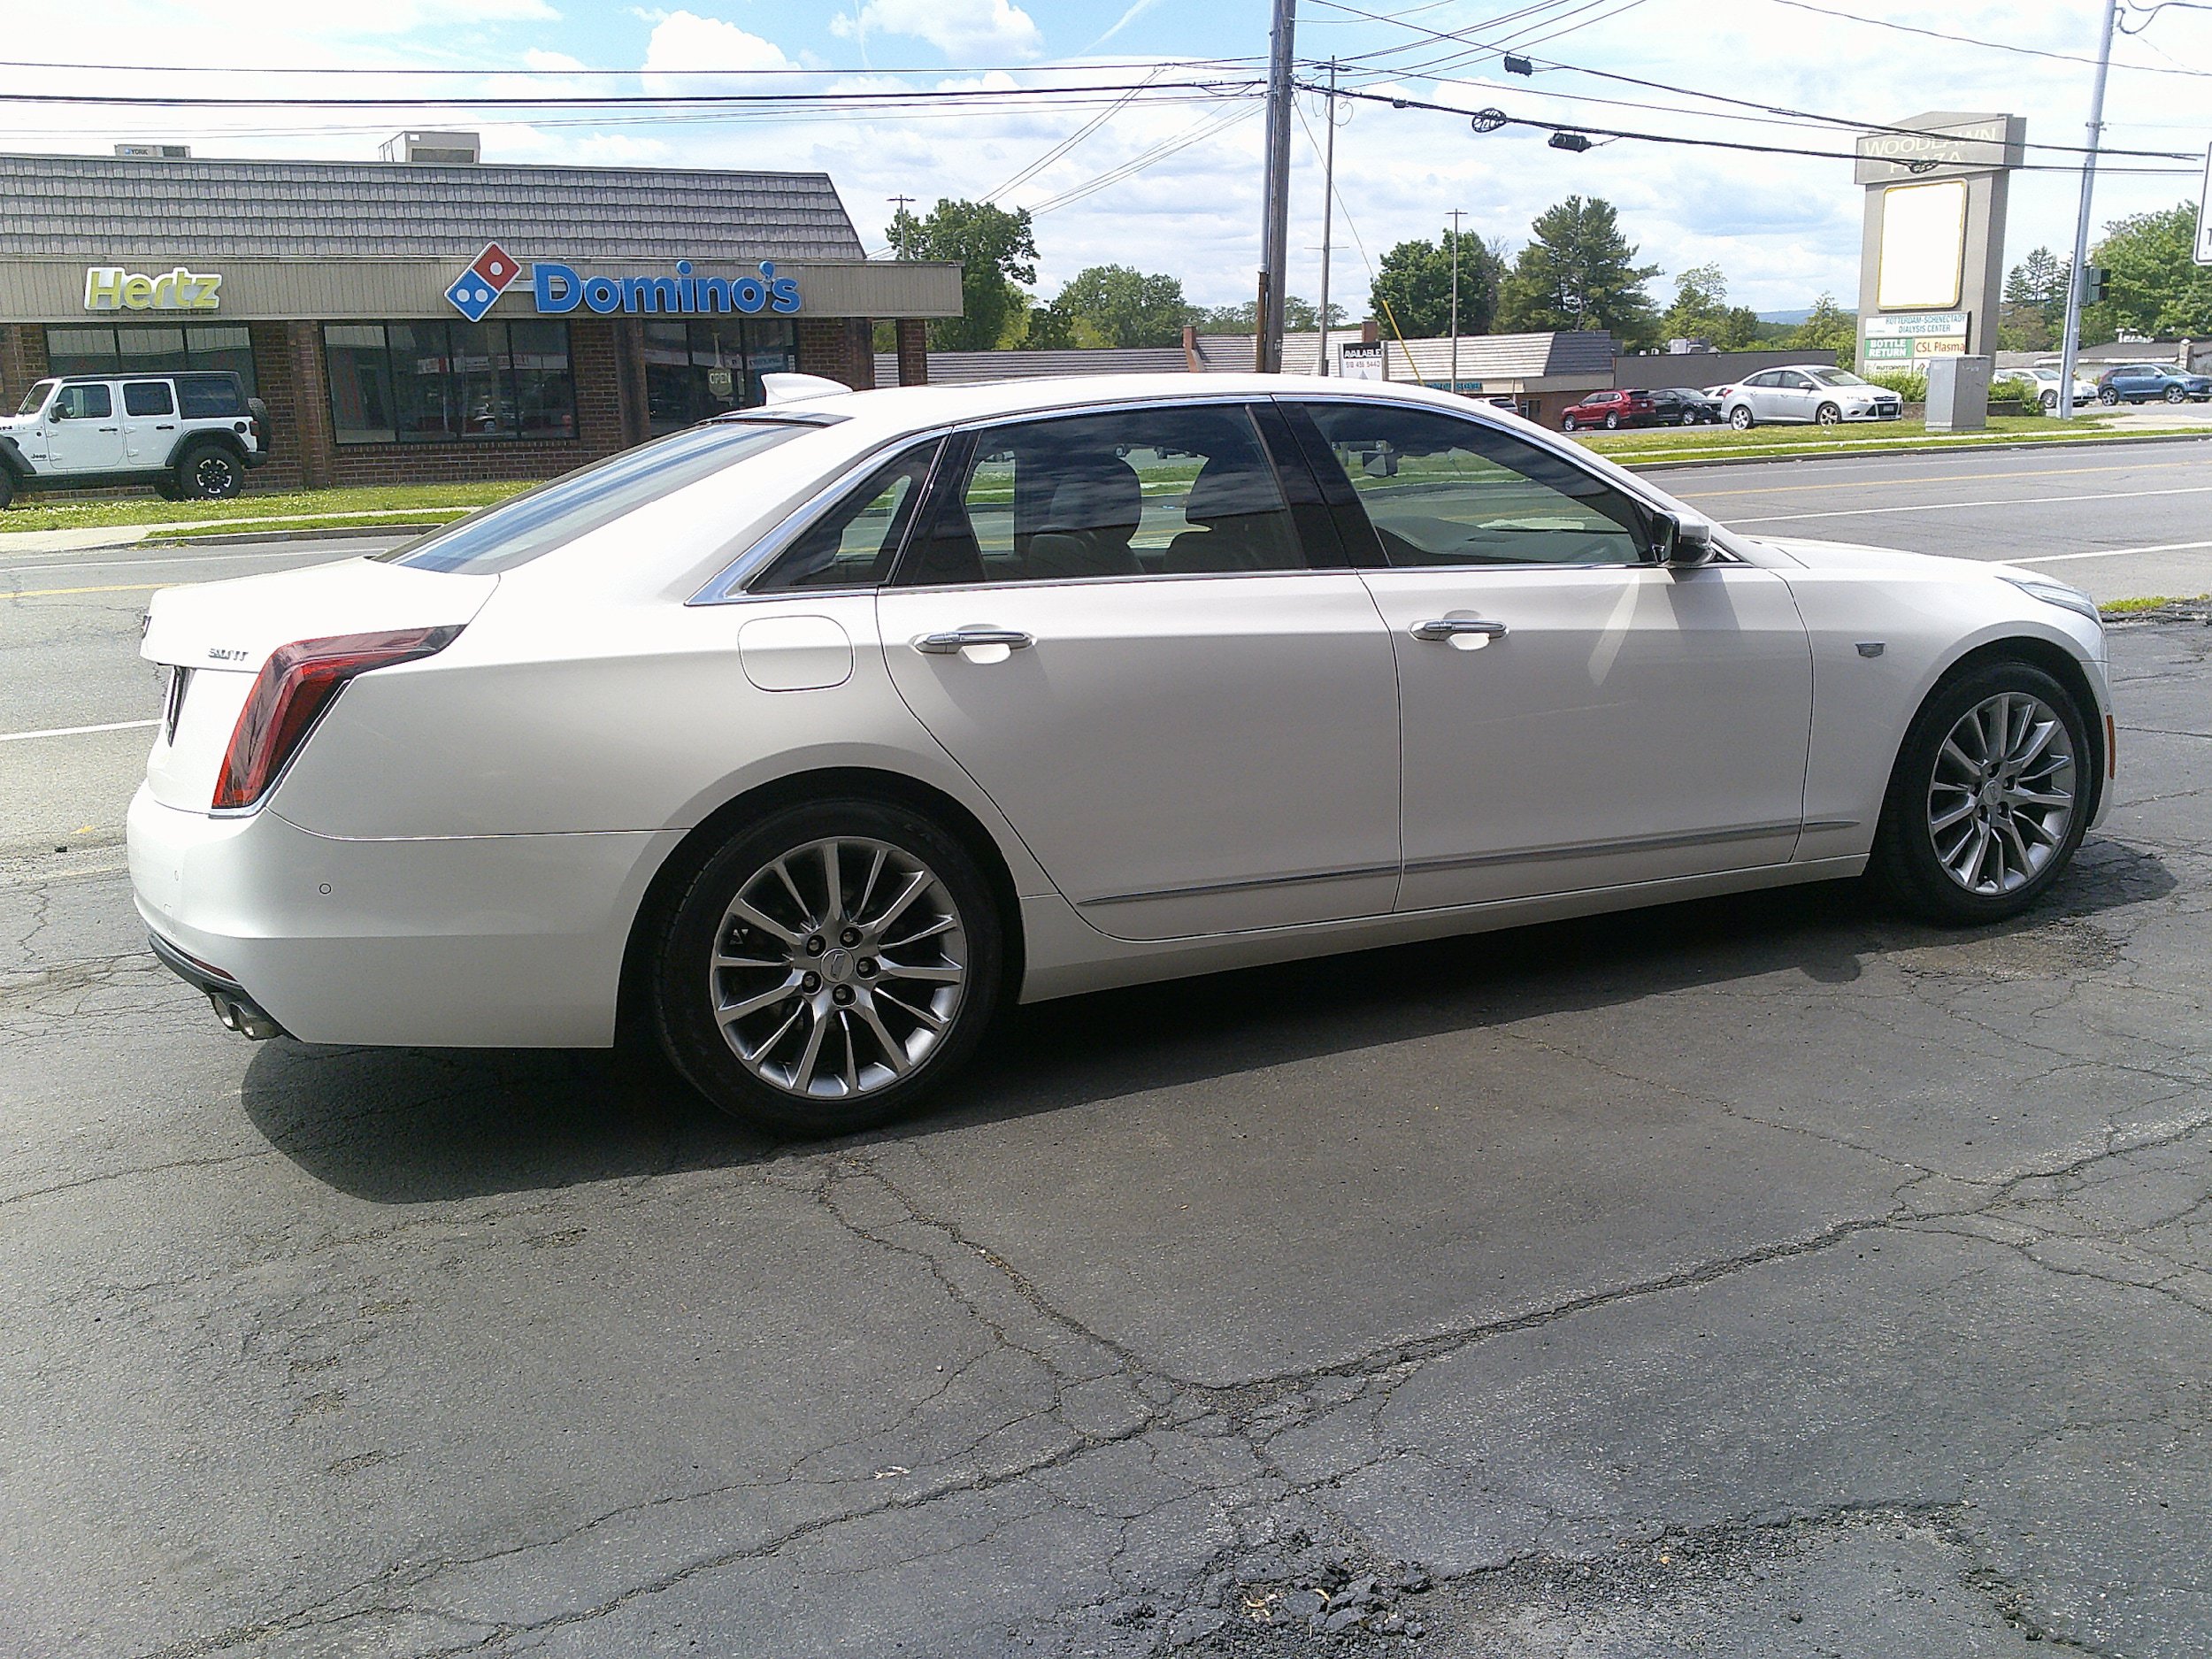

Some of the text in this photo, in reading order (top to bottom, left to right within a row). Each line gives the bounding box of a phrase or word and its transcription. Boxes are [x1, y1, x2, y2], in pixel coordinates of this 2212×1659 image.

[89, 270, 220, 309] Hertz
[532, 260, 802, 313] Domino's
[1927, 324, 1951, 333] CENTER
[1870, 338, 1907, 348] BOTTLE
[1916, 341, 1965, 352] CSL Plasma
[1345, 349, 1381, 357] AVAILABLE
[1869, 348, 1907, 357] RETURN
[709, 373, 732, 384] OPEN
